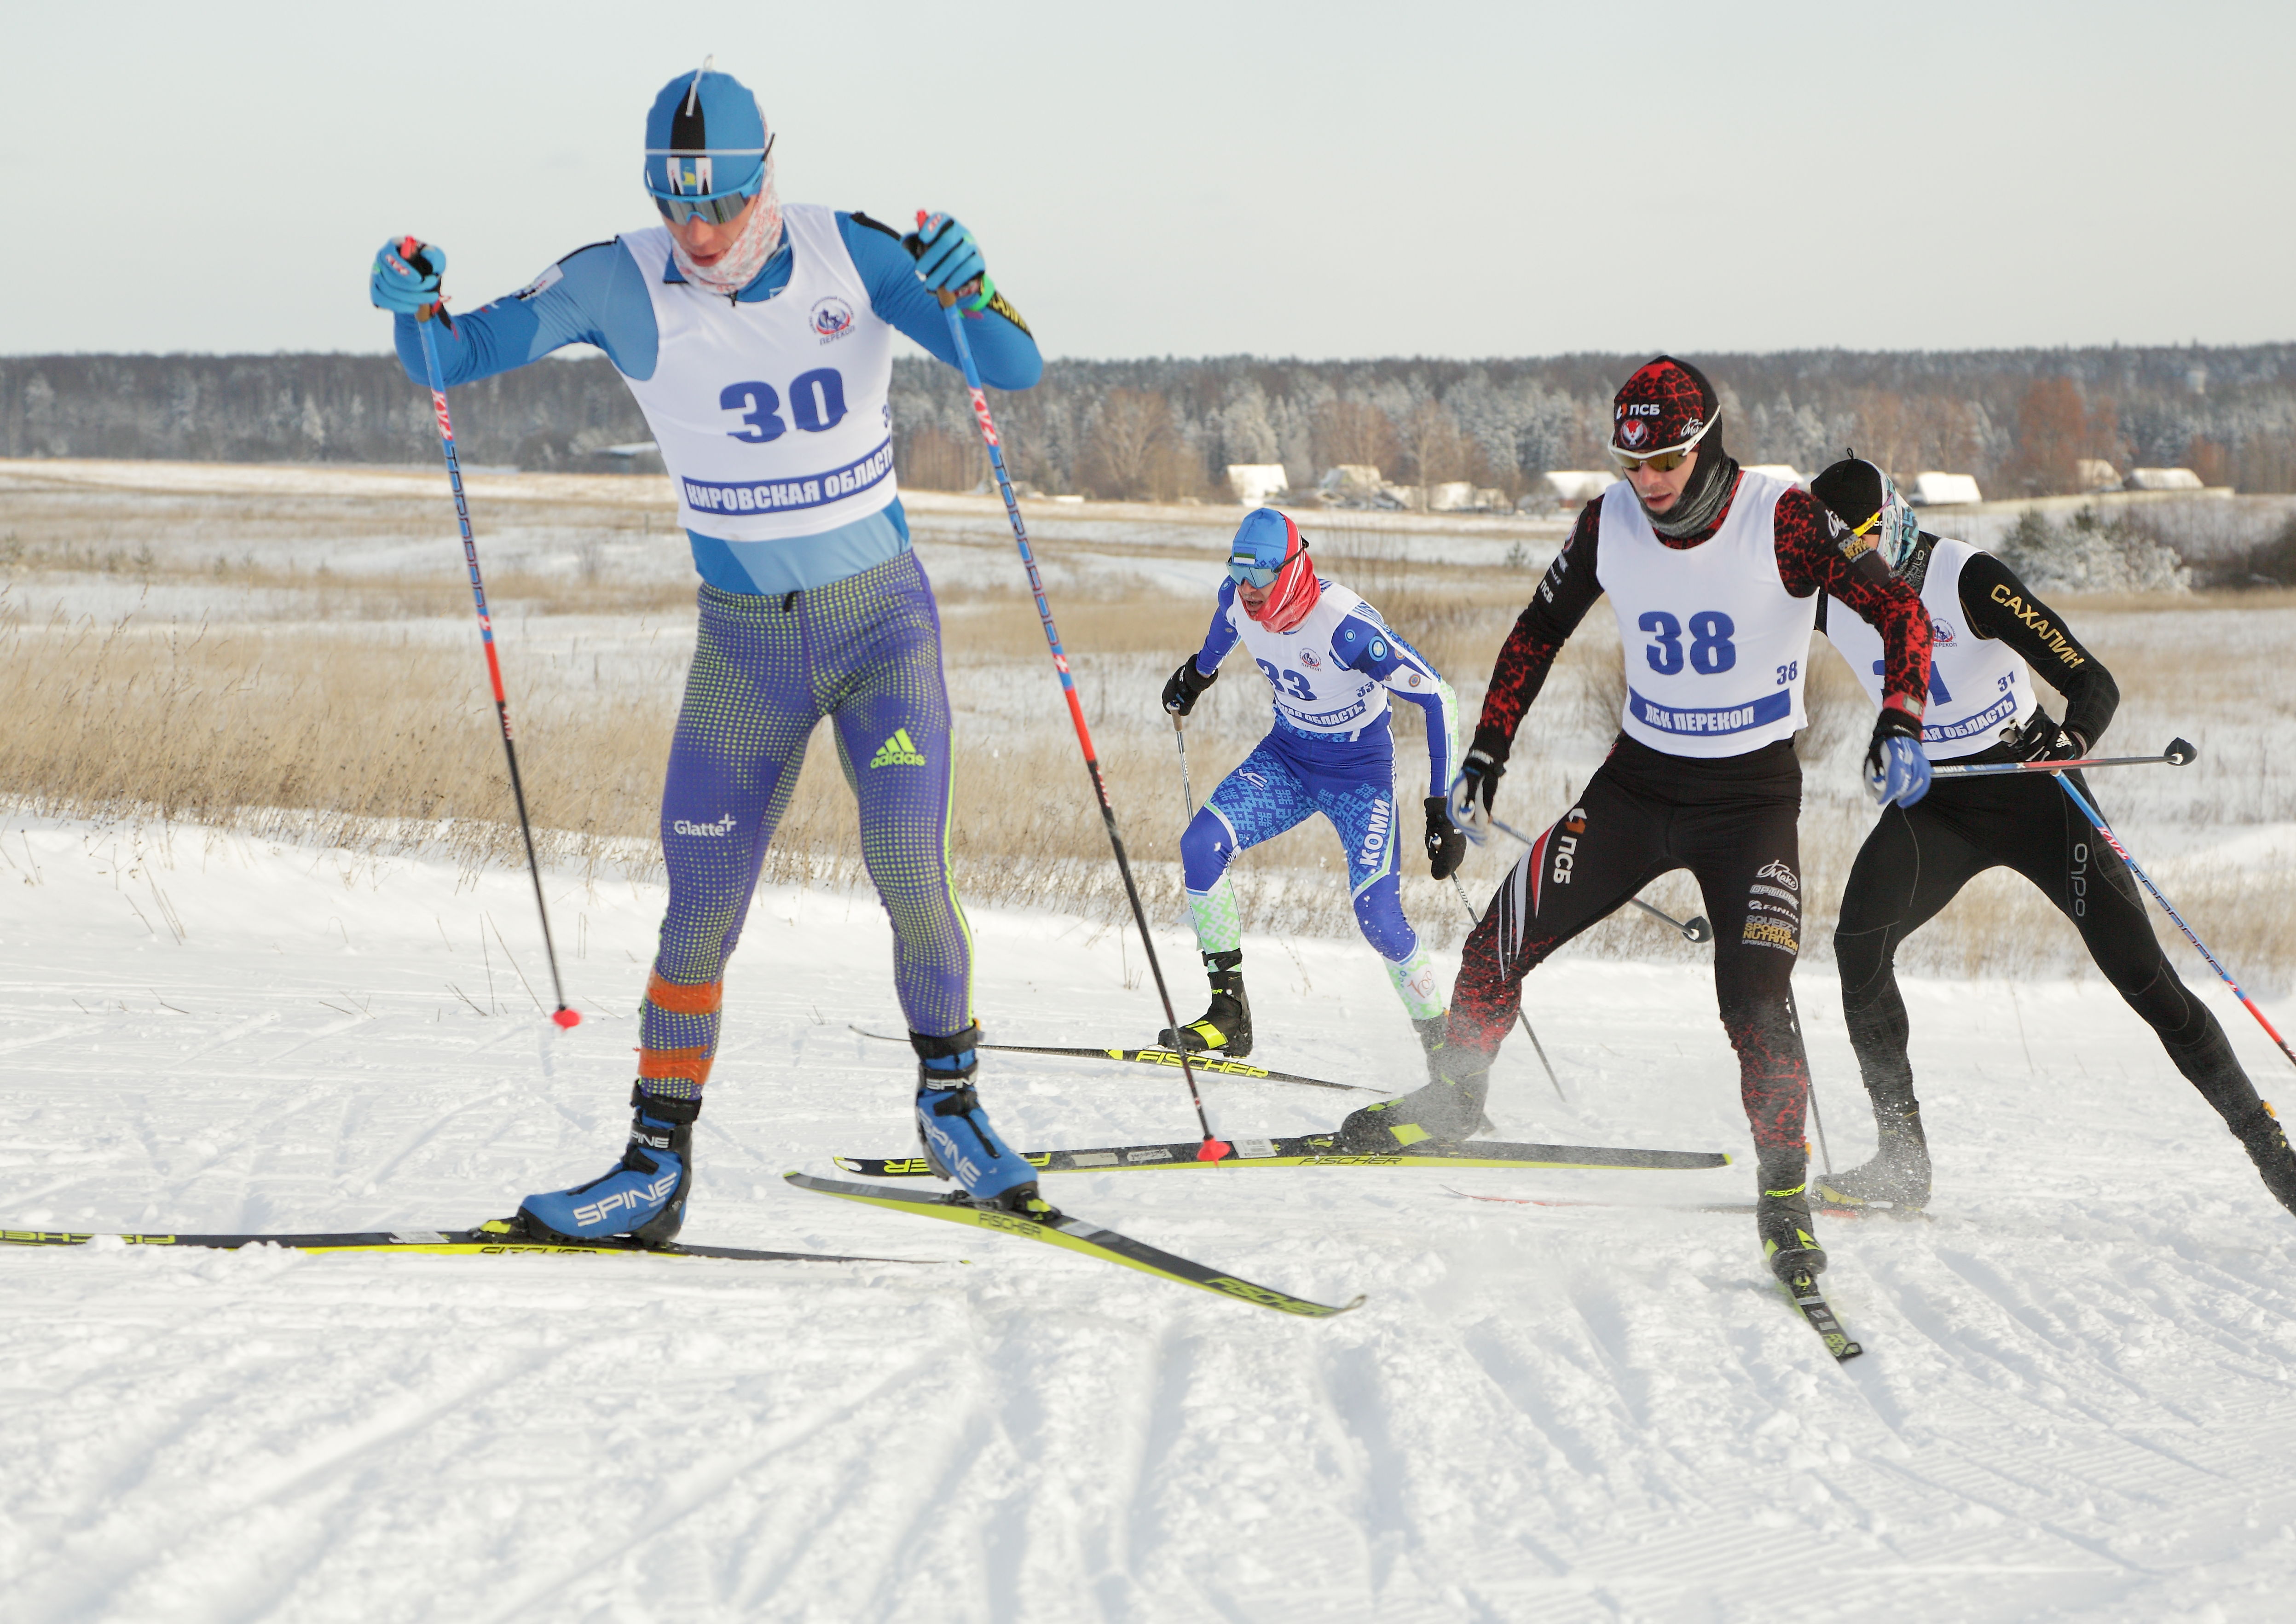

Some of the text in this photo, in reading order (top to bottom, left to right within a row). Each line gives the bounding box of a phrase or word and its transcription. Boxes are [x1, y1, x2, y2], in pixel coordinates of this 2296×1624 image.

[820, 325, 855, 346] ПЕРЕКОП
[719, 367, 848, 443] 30
[882, 404, 891, 429] 3
[1630, 404, 1660, 416] ПСБ
[685, 481, 821, 511] КИРОВСКАЯ
[1540, 579, 1554, 604] ПСБ
[1991, 584, 2085, 669] САХАЛИН
[1638, 611, 1736, 675] 38
[1255, 658, 1318, 701] 33
[1301, 663, 1321, 672] ПЕРЕКОП
[1777, 661, 1798, 685] 38
[1356, 681, 1375, 697] 33
[1997, 671, 2015, 692] 31
[1304, 703, 1363, 725] ОБЛАСТЬ
[1645, 703, 1754, 731] ЛБК ПЕРЕКОП
[1943, 699, 2014, 738] ОБЛАСТЬ
[870, 752, 925, 769] adidas
[1359, 798, 1390, 867] КОМИ
[1553, 835, 1578, 884] ПСБ
[1750, 884, 1799, 910] OPTIWAX
[1745, 922, 1792, 939] SPORTS
[1747, 915, 1798, 934] SQUEEZY
[1742, 939, 1772, 949] UPGRADE
[1743, 930, 1799, 951] NUTRITION
[1135, 1050, 1269, 1078] FISCHER
[630, 1131, 670, 1148] PINE
[919, 1108, 982, 1188] SPINE
[1298, 1157, 1402, 1165] FISCHER
[573, 1172, 677, 1227] SPINE
[978, 1212, 1042, 1240] FISCHER
